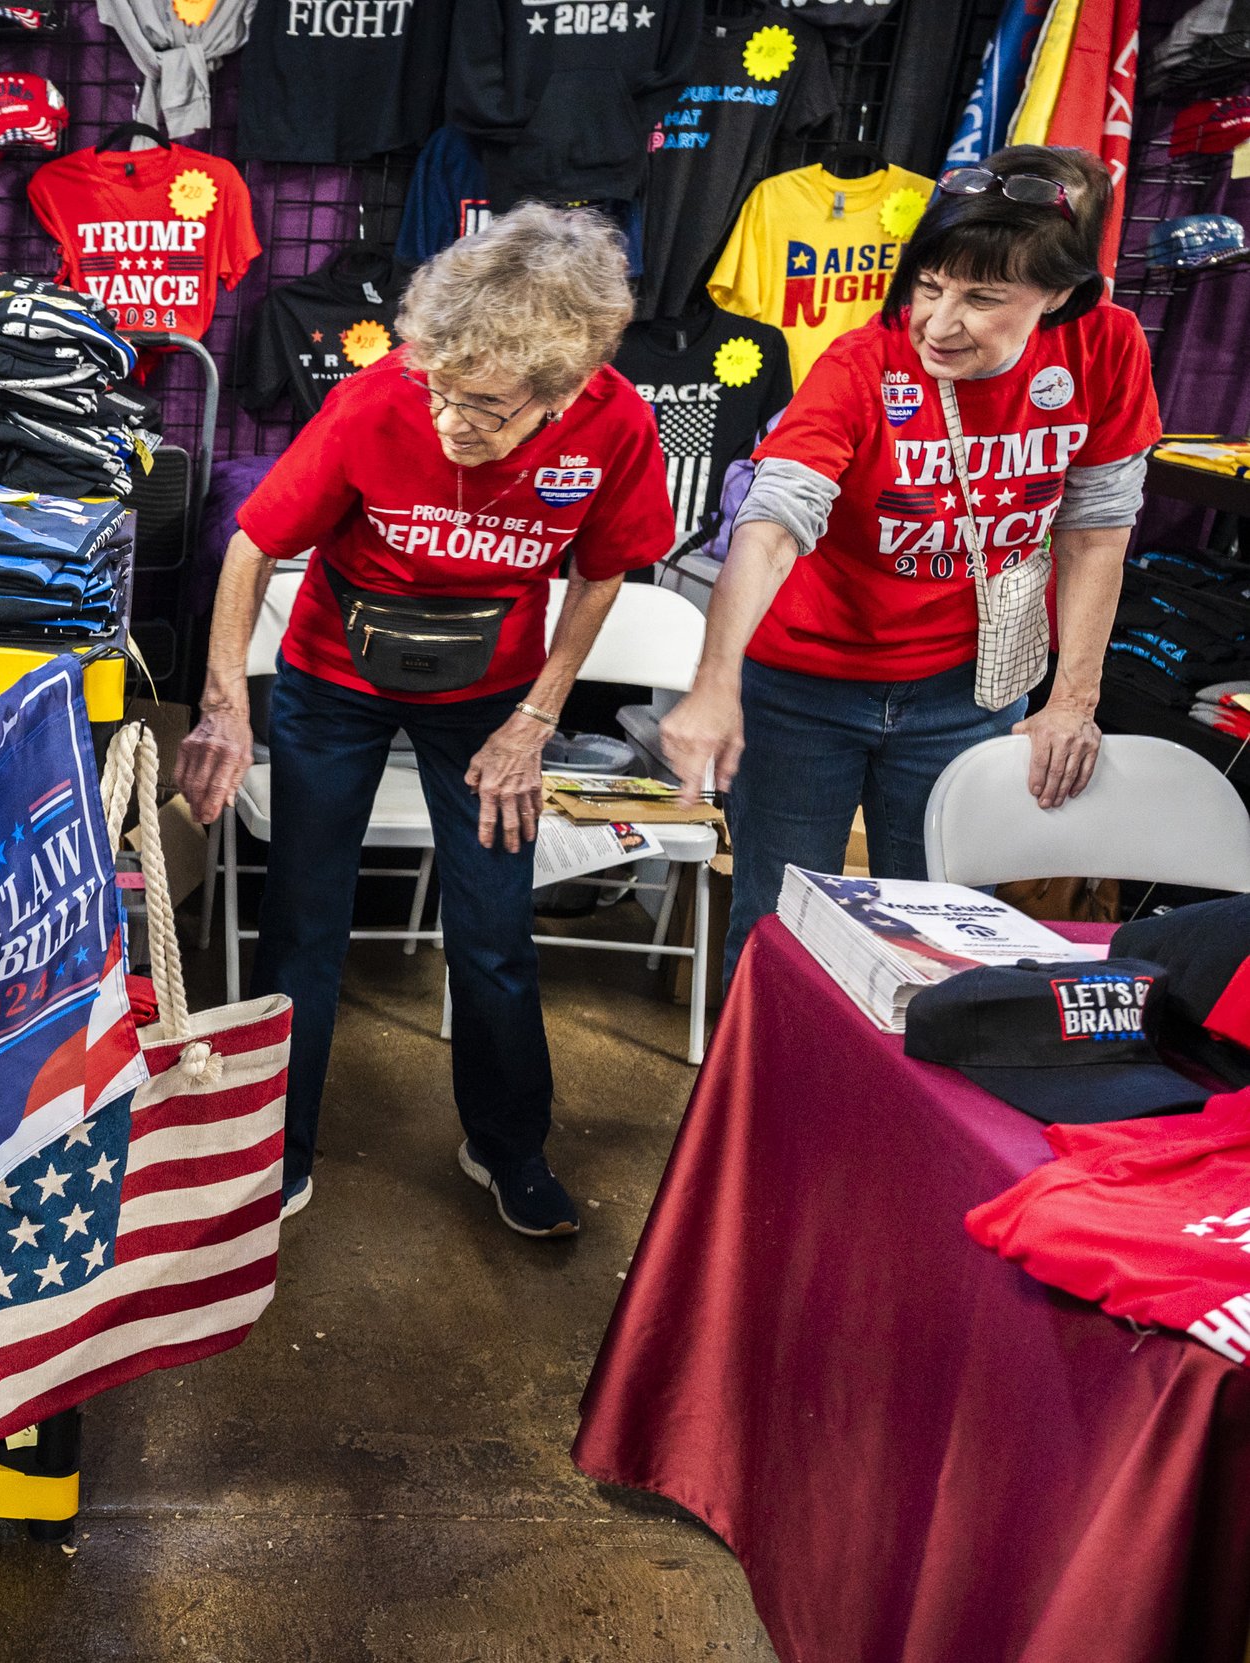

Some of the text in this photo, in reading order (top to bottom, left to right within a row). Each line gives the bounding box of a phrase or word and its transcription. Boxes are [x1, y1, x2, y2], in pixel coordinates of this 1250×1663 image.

[286, 0, 414, 38] FIGHT
[554, 2, 629, 35] 2024
[678, 85, 779, 106] PUBLICANS
[77, 220, 206, 253] TRUMP
[84, 274, 199, 306] VANCE
[883, 370, 910, 383] Vote
[635, 383, 723, 403] BACK
[559, 454, 589, 468] Vote
[894, 423, 1089, 487] TRUMP
[411, 504, 543, 536] PROUD TO BE A
[877, 495, 1062, 555] VANCE
[895, 550, 1022, 579] 2024
[878, 902, 1009, 913] Voter Guide
[1058, 982, 1133, 1008] LET'S
[1063, 1007, 1143, 1034] BRAND
